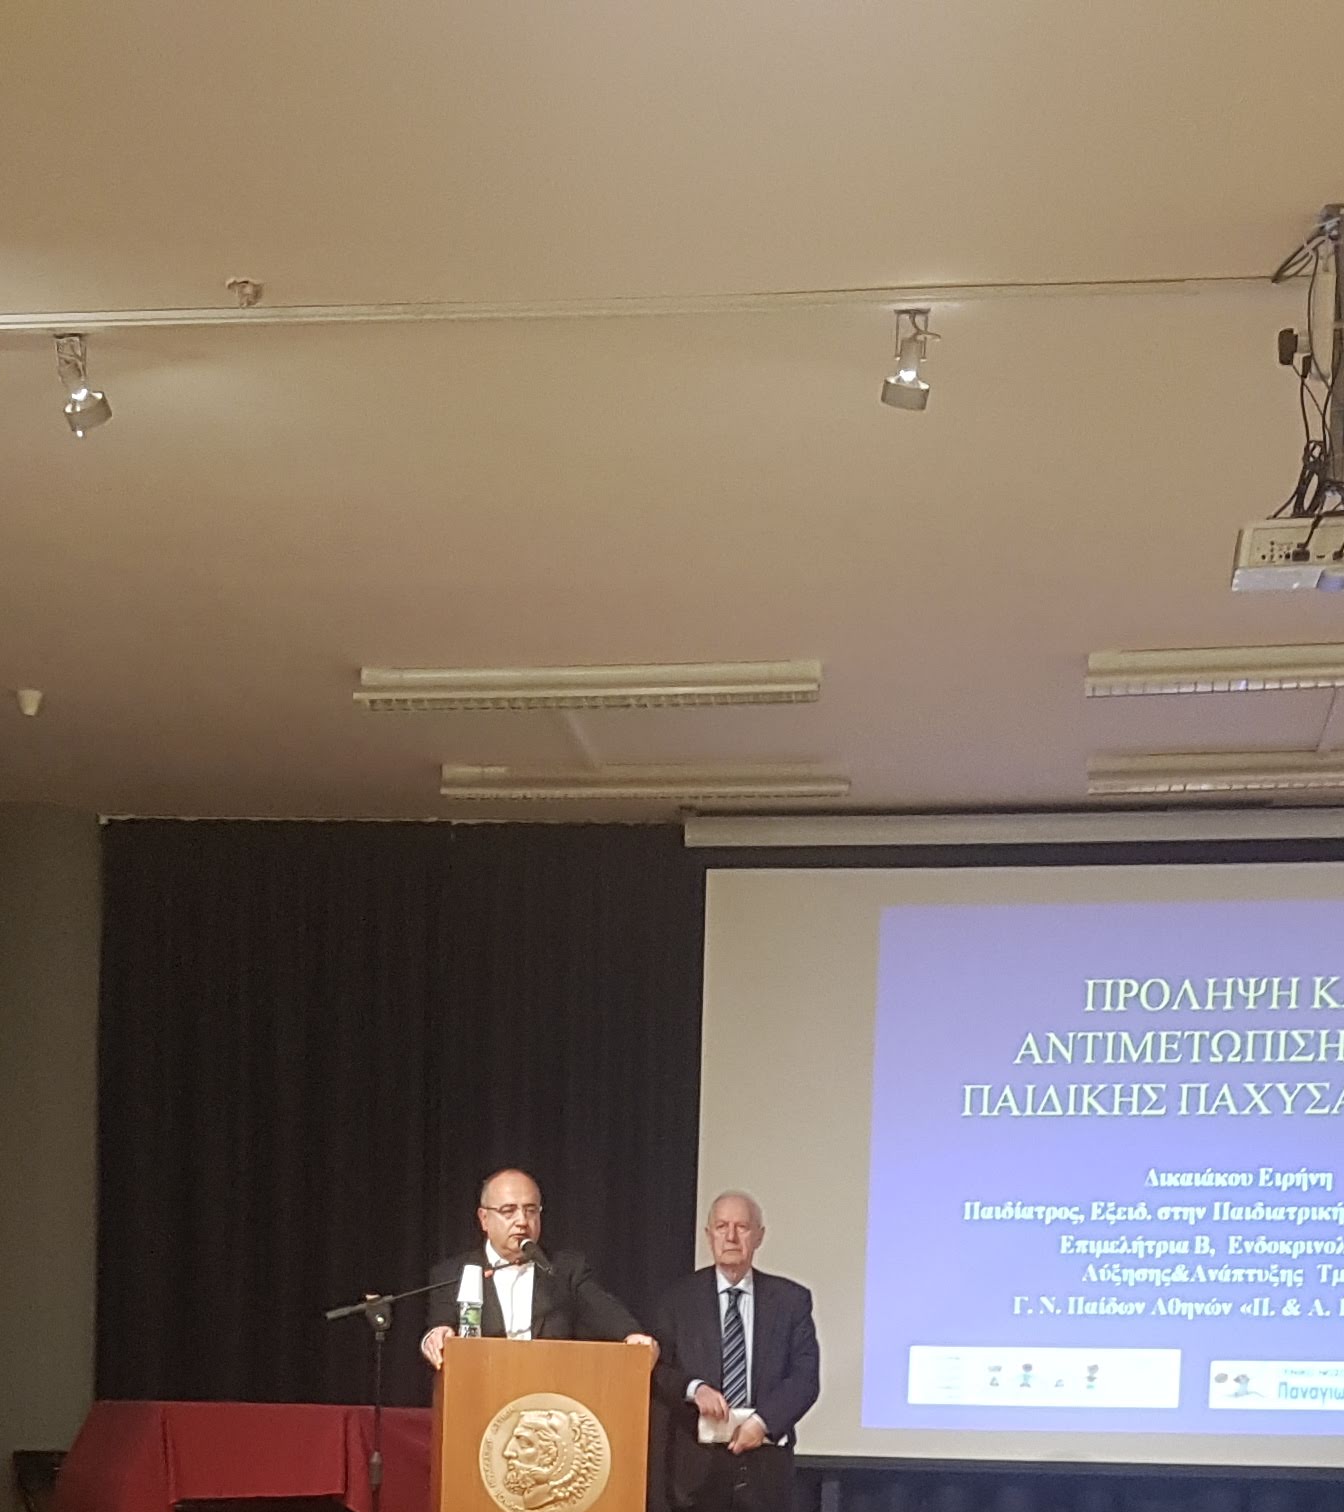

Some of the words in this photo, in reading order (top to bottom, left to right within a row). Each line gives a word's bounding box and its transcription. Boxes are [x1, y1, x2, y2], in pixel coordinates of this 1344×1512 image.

[1083, 976, 1300, 1012] ΠΡΟΛΗΨΗ
[960, 1083, 1168, 1117] ΠΑΙΔΙΚΗΣ
[1144, 1167, 1254, 1188] Δικαιάκου
[1257, 1167, 1334, 1191] Ειρήνη
[962, 1200, 1085, 1225] Παιδίατρος,
[1090, 1201, 1152, 1225] Εξειδ.
[1156, 1205, 1207, 1225] στην
[1059, 1235, 1189, 1258] Επιμελήτρια
[1194, 1235, 1216, 1257] Β,
[1012, 1296, 1033, 1316] Γ.
[1039, 1296, 1061, 1316] Ν.
[1067, 1296, 1146, 1316] Παίδων
[1151, 1296, 1233, 1320] Αθηνών
[1281, 1297, 1301, 1317] &
